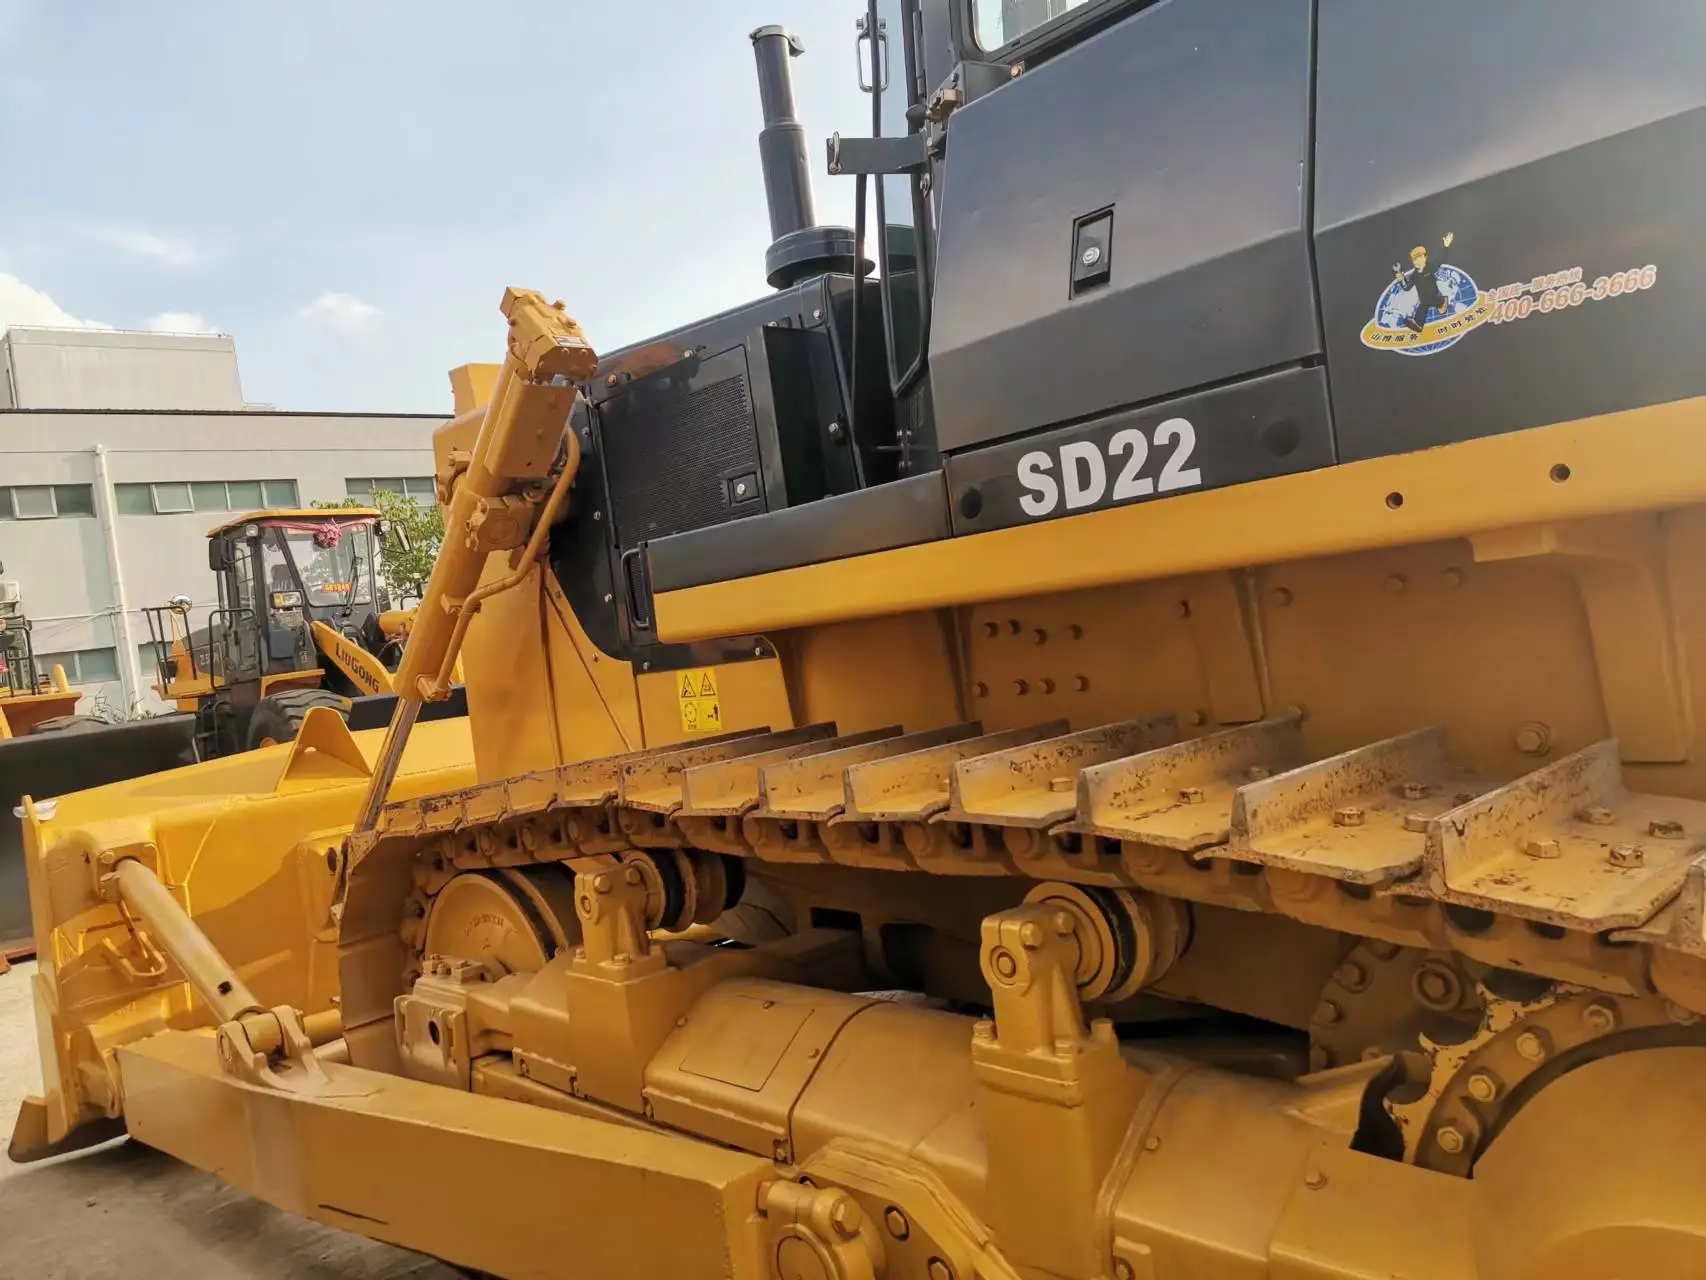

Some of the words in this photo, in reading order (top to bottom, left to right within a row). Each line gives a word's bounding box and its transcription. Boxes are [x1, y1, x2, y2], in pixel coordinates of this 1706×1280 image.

[1487, 264, 1657, 324] 400-666-3666
[1017, 417, 1202, 517] SD22
[335, 640, 380, 693] LIUGONG
